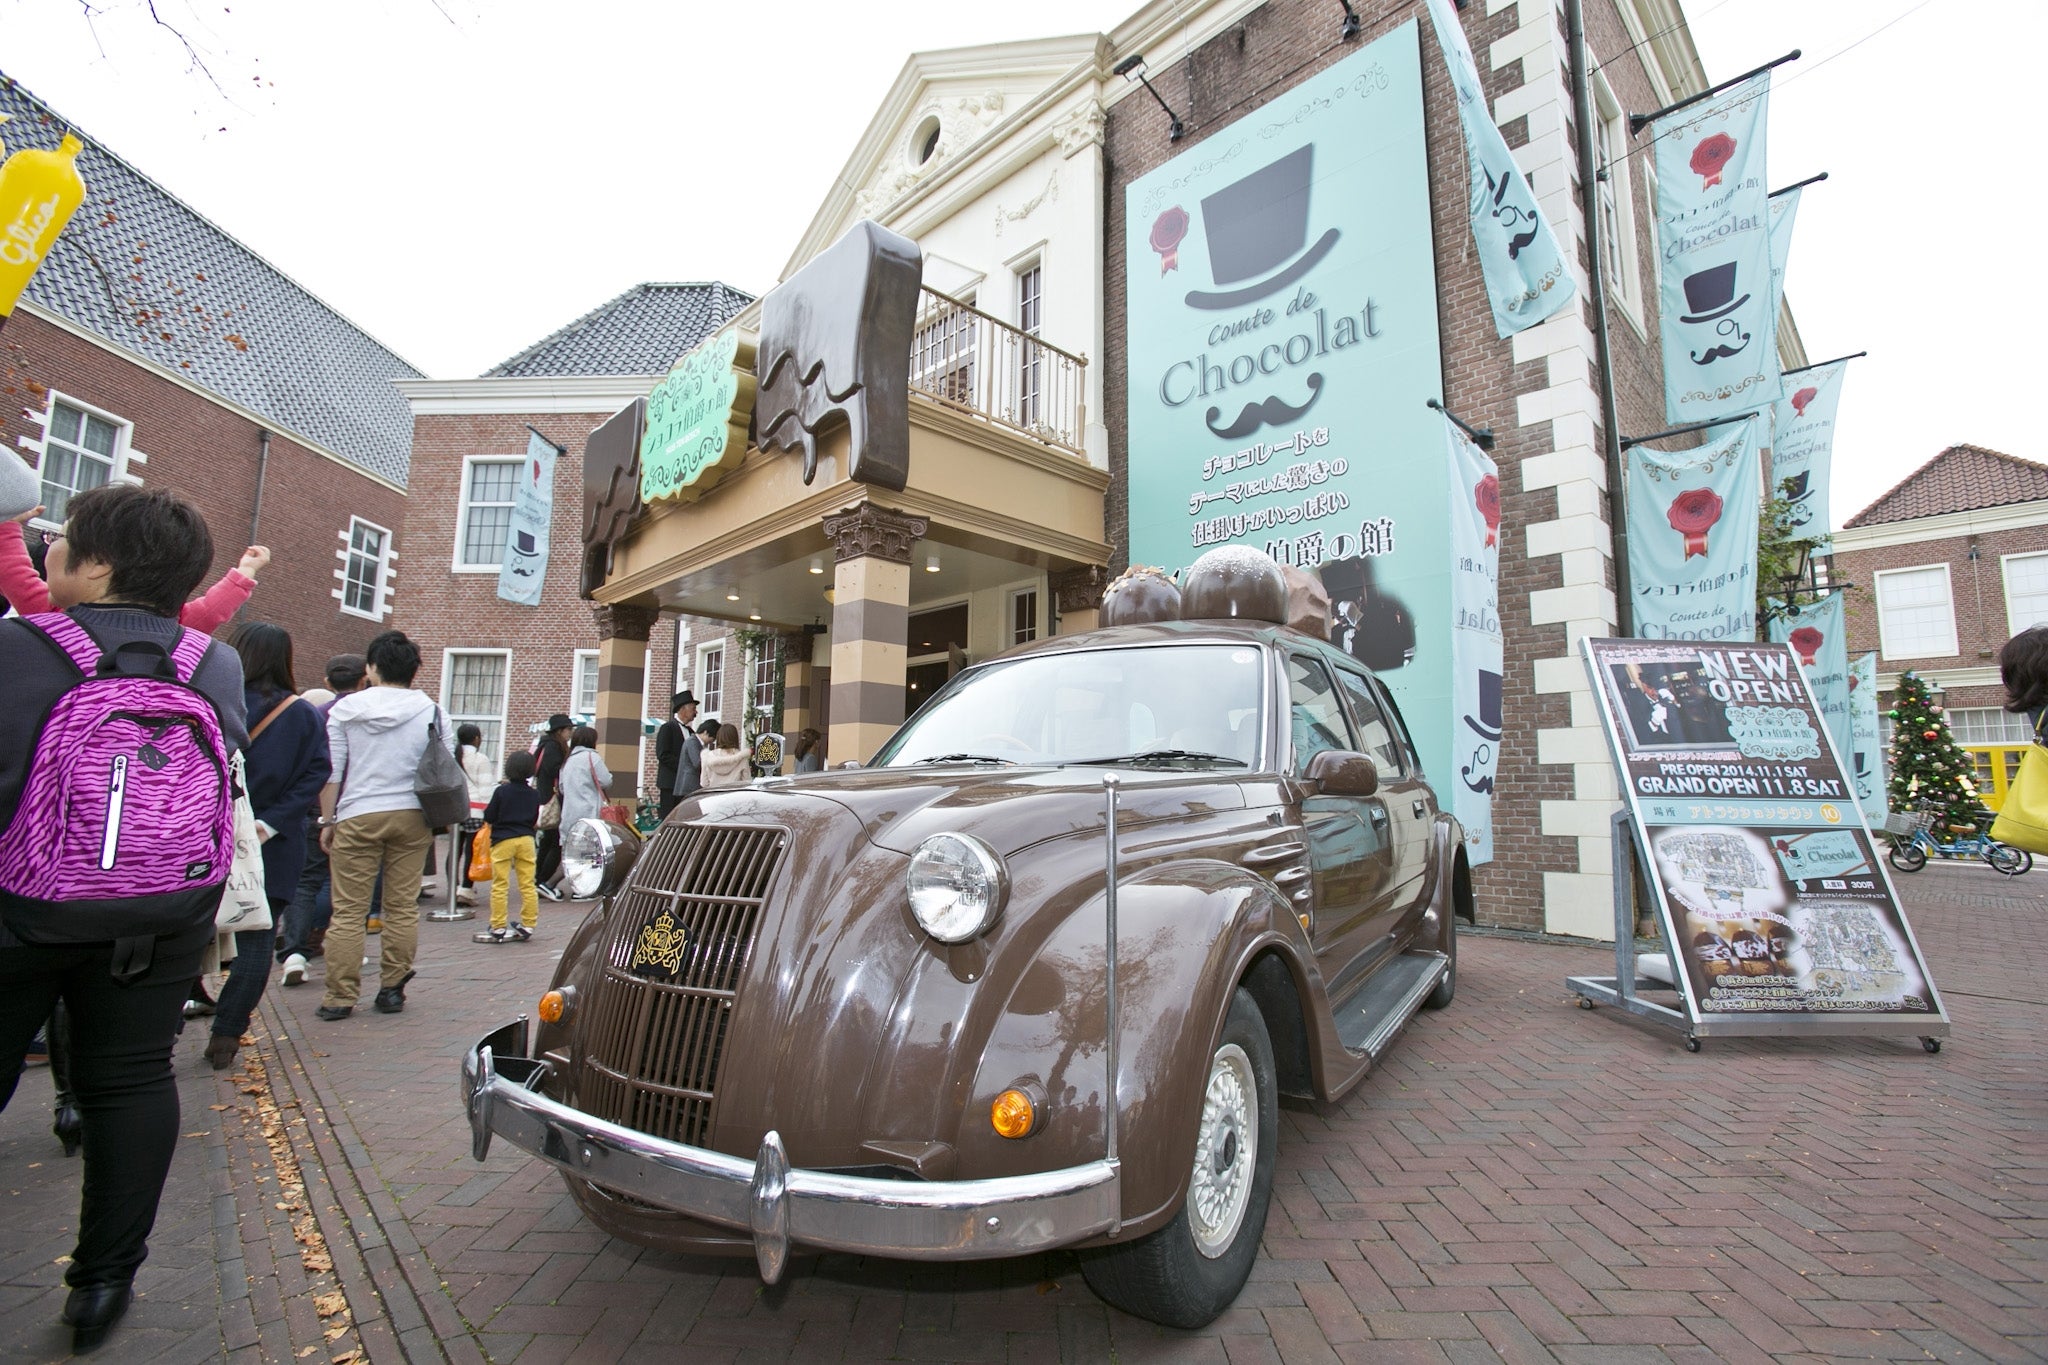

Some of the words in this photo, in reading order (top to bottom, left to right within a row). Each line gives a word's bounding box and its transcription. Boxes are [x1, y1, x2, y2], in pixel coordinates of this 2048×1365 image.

[1665, 214, 1760, 260] Chocolat
[1207, 308, 1276, 347] Comte
[1286, 285, 1318, 318] de
[1158, 296, 1383, 408] Chocolat
[1203, 427, 1329, 480] チョコレートを
[1189, 457, 1348, 515] テーマにした驚きの
[1191, 491, 1350, 547] 仕掛けがいっぱい
[1669, 609, 1709, 623] Comte
[1712, 603, 1726, 617] de
[1699, 650, 1788, 680] NEW
[1709, 680, 1805, 703] OPEN!
[1637, 776, 1706, 794] GRAND
[1707, 777, 1761, 795] OPEN
[1762, 777, 1806, 796] 11.8
[1806, 778, 1840, 797] SAT
[1660, 763, 1686, 776] PRE
[1686, 764, 1721, 777] OPEN
[1721, 764, 1783, 778] 2014.11.1
[1784, 765, 1808, 778] SAT
[1807, 848, 1859, 862] Chocolat
